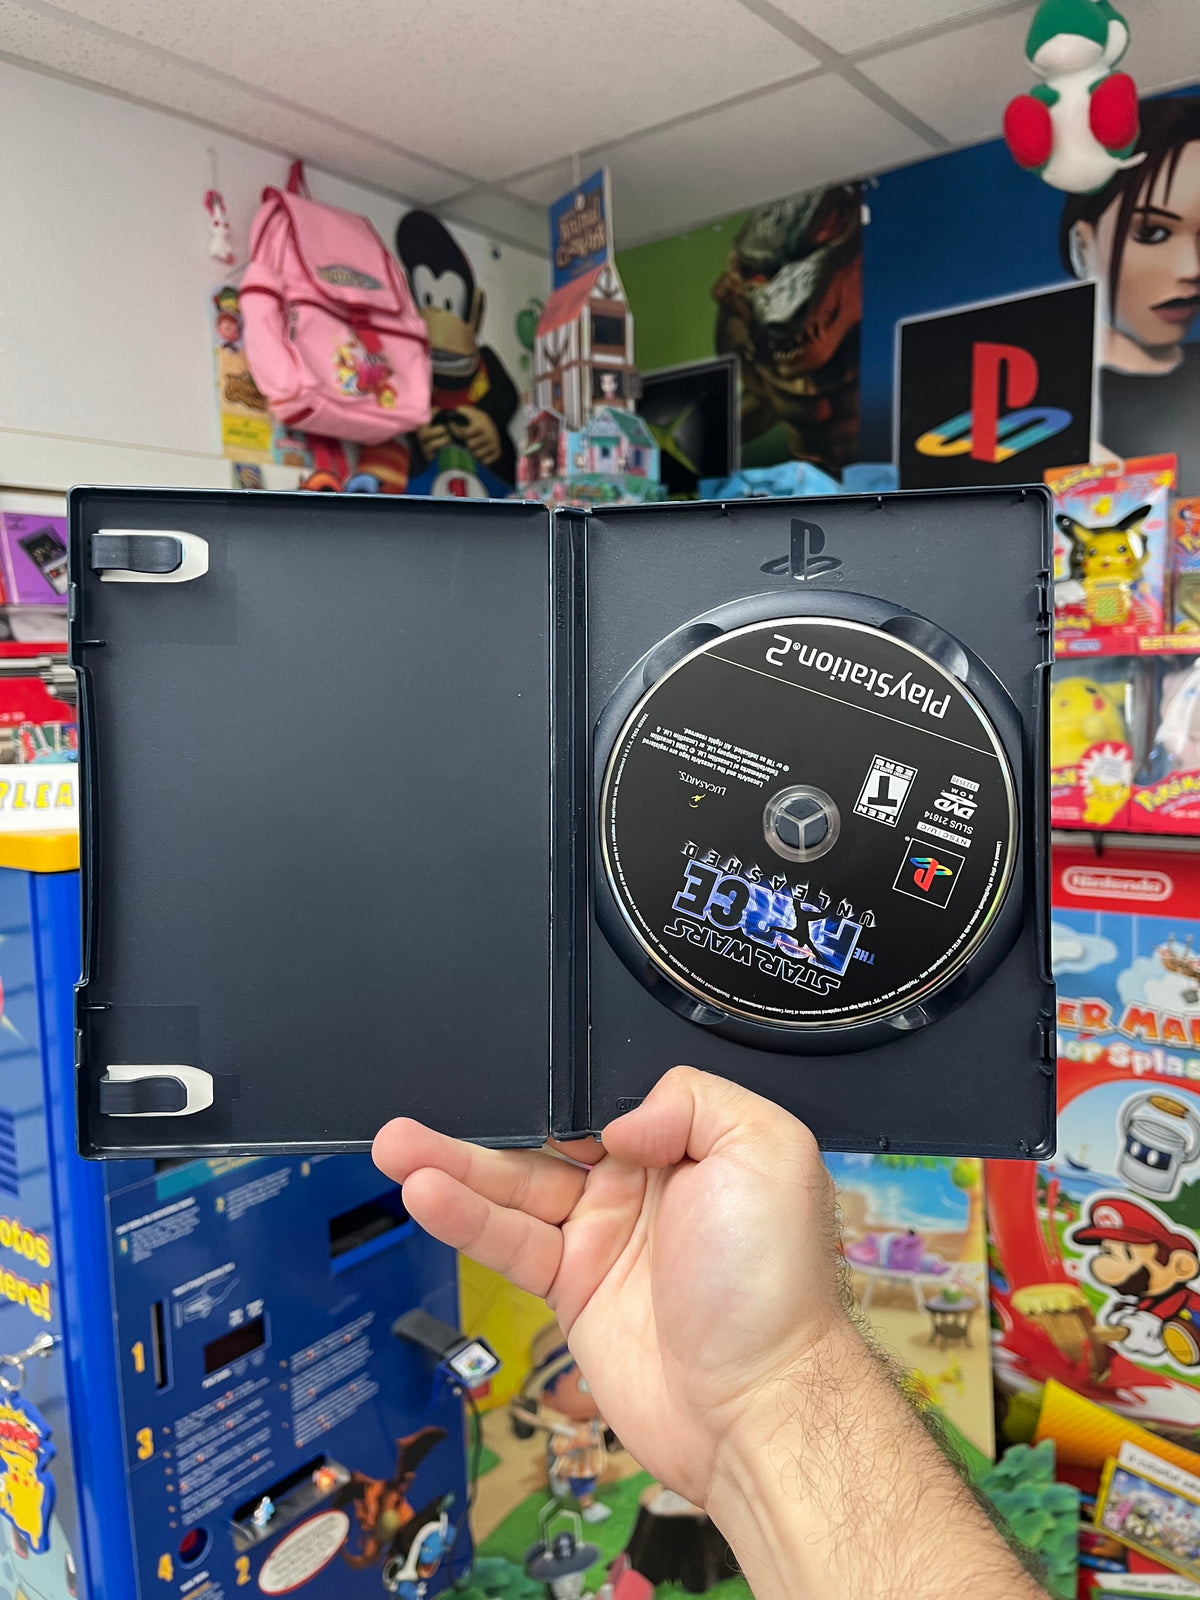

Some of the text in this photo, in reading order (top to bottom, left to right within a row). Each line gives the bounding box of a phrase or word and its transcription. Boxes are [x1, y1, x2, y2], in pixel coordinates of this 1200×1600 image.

[678, 751, 691, 761] logo
[716, 765, 726, 774] the
[679, 771, 727, 796] LUCASARTS
[867, 775, 898, 808] T
[856, 804, 896, 825] TEEN
[934, 798, 975, 820] DVD
[924, 810, 974, 835] SLUS 21614
[680, 839, 877, 928] UNLEASHED
[1072, 873, 1163, 894] Nintendo
[664, 917, 841, 997] STAR WARS
[853, 946, 876, 966] THE
[132, 1341, 145, 1373] 1
[137, 1427, 154, 1460] 3
[158, 1553, 173, 1582] 4
[235, 1556, 251, 1586] 2
